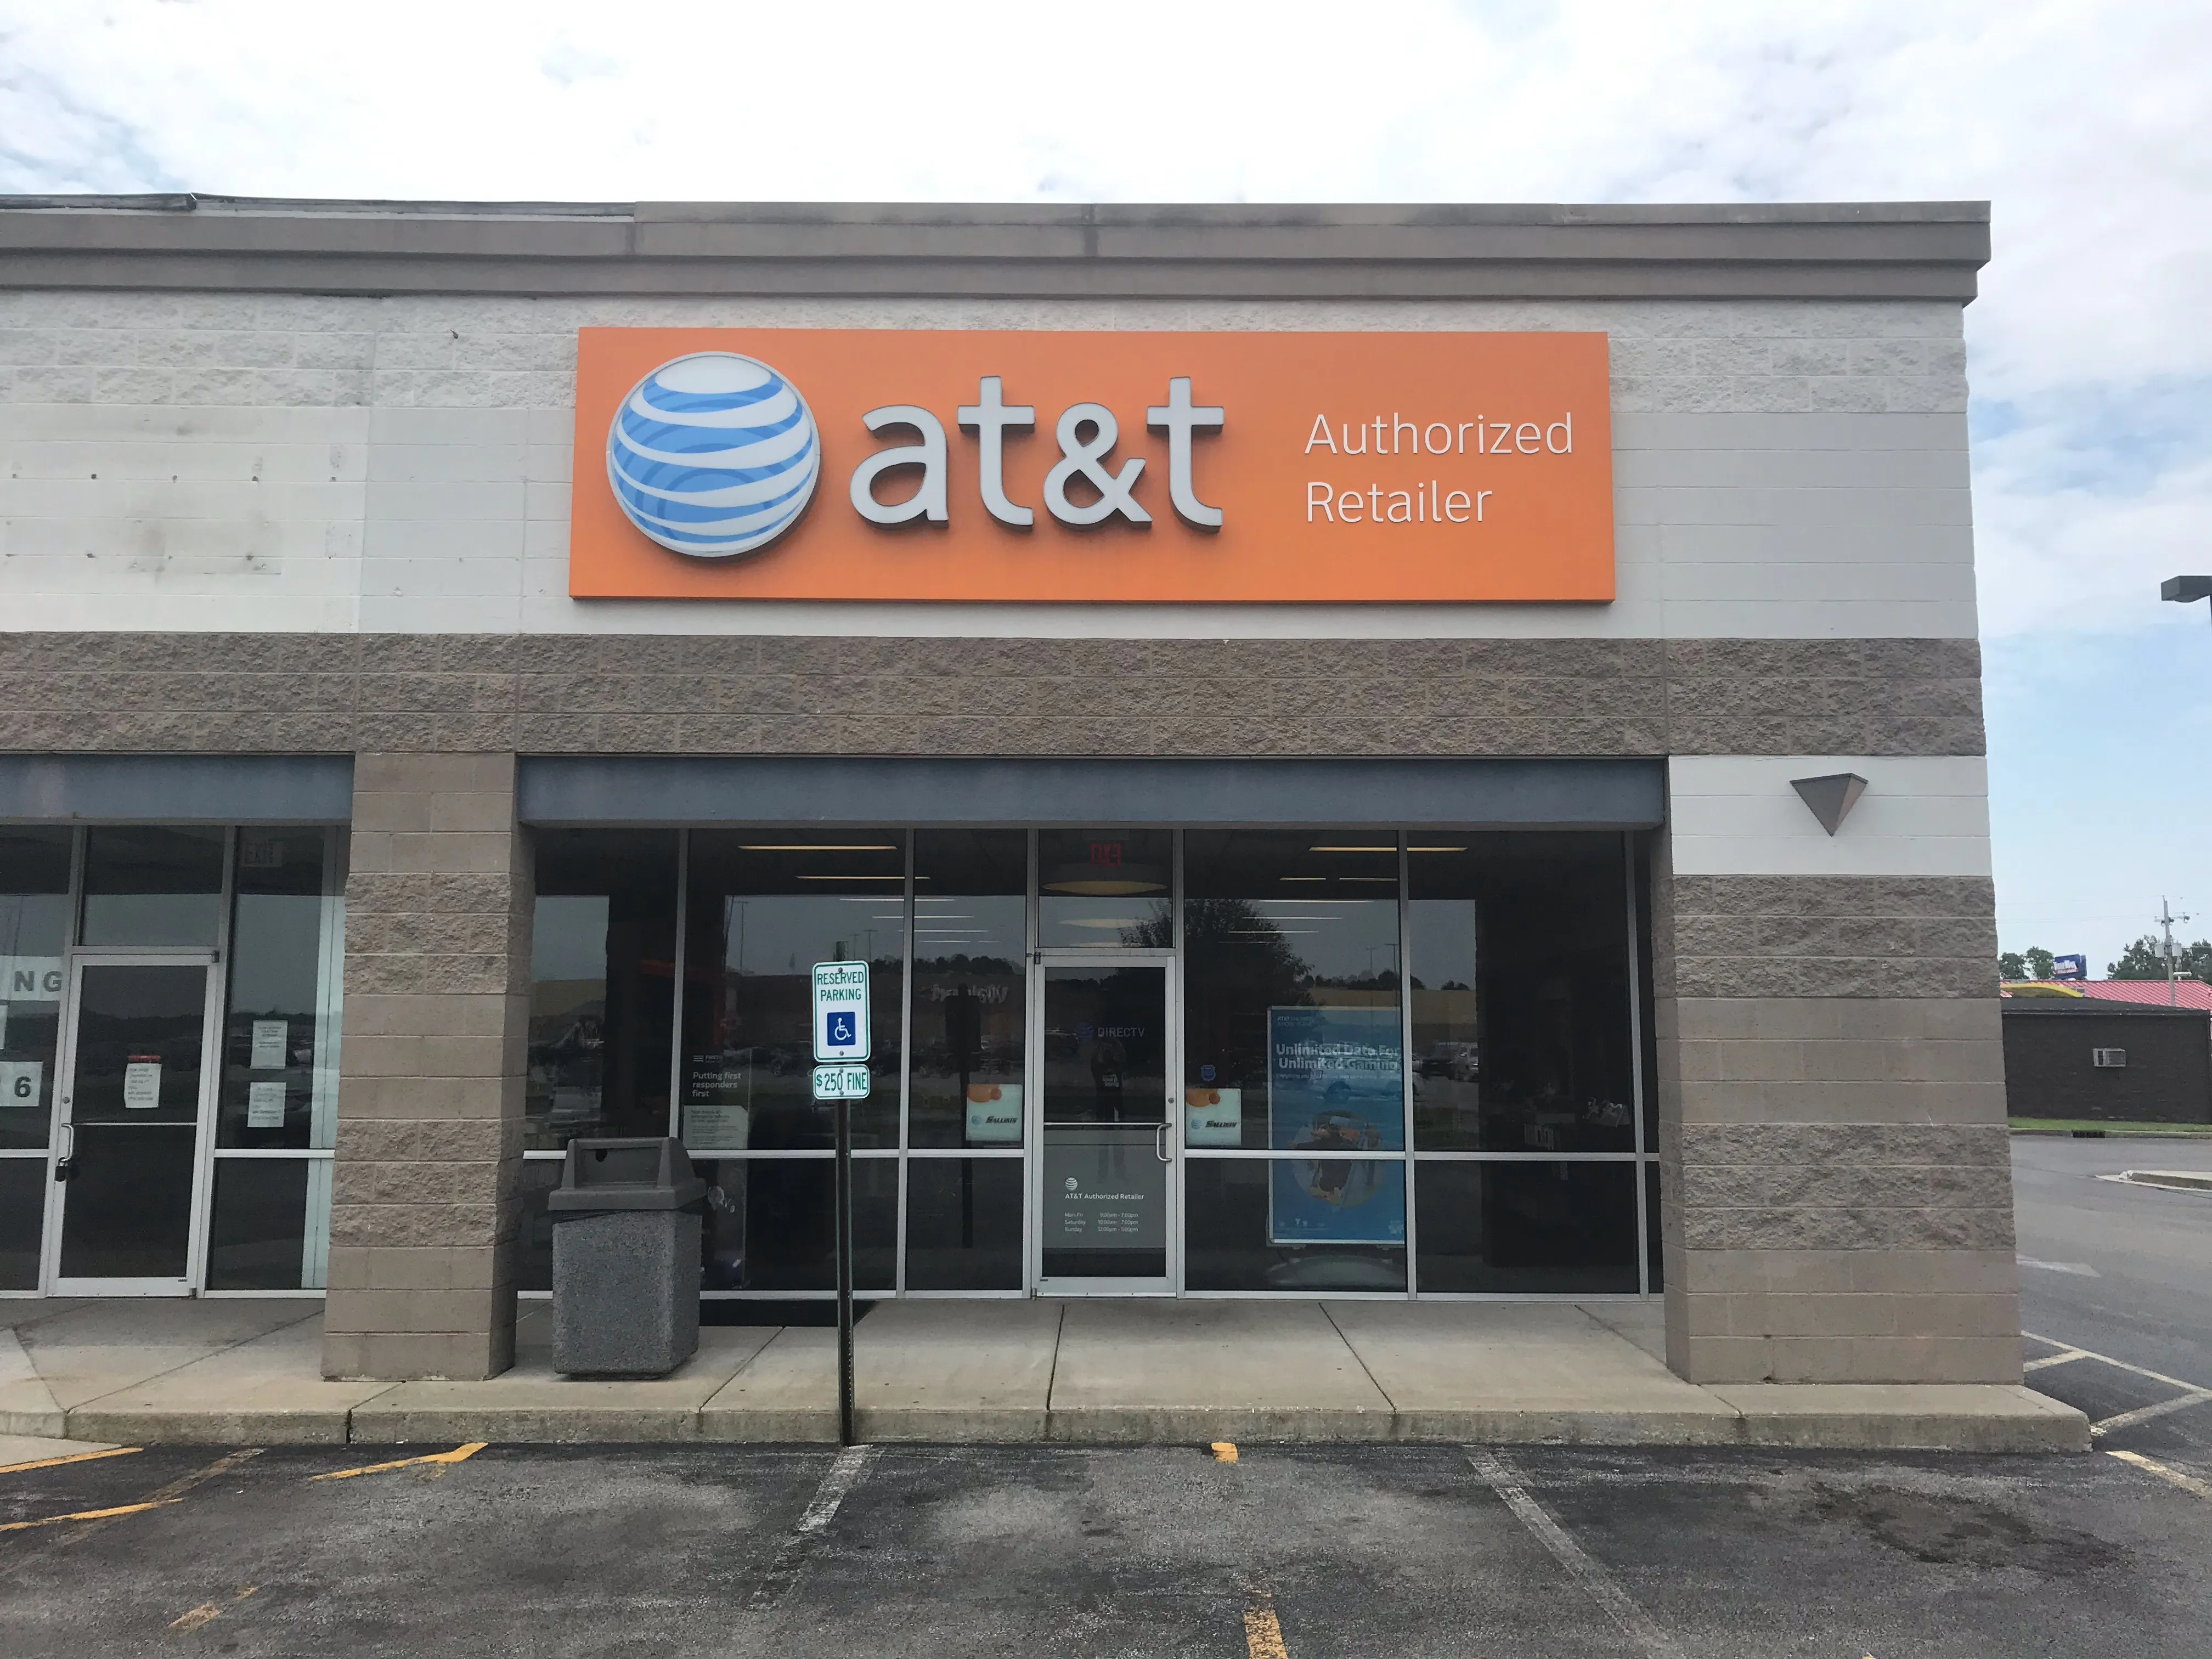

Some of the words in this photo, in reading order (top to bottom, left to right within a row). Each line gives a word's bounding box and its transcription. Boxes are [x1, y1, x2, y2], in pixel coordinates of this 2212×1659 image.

[1305, 412, 1572, 454] Authorized
[850, 375, 1224, 533] at&t
[1307, 480, 1492, 523] Retailer
[817, 971, 864, 985] RESERVED
[821, 989, 861, 1002] PARKING
[1097, 1027, 1145, 1037] DIRECTV
[1276, 1043, 1340, 1056] Unlimited
[1344, 1045, 1378, 1056] Data
[1279, 1057, 1344, 1069] Unlimited
[693, 1071, 723, 1080] Putting
[724, 1071, 741, 1080] first
[847, 1072, 867, 1091] FINE
[14, 1076, 31, 1098] 6
[692, 1081, 737, 1089] responders
